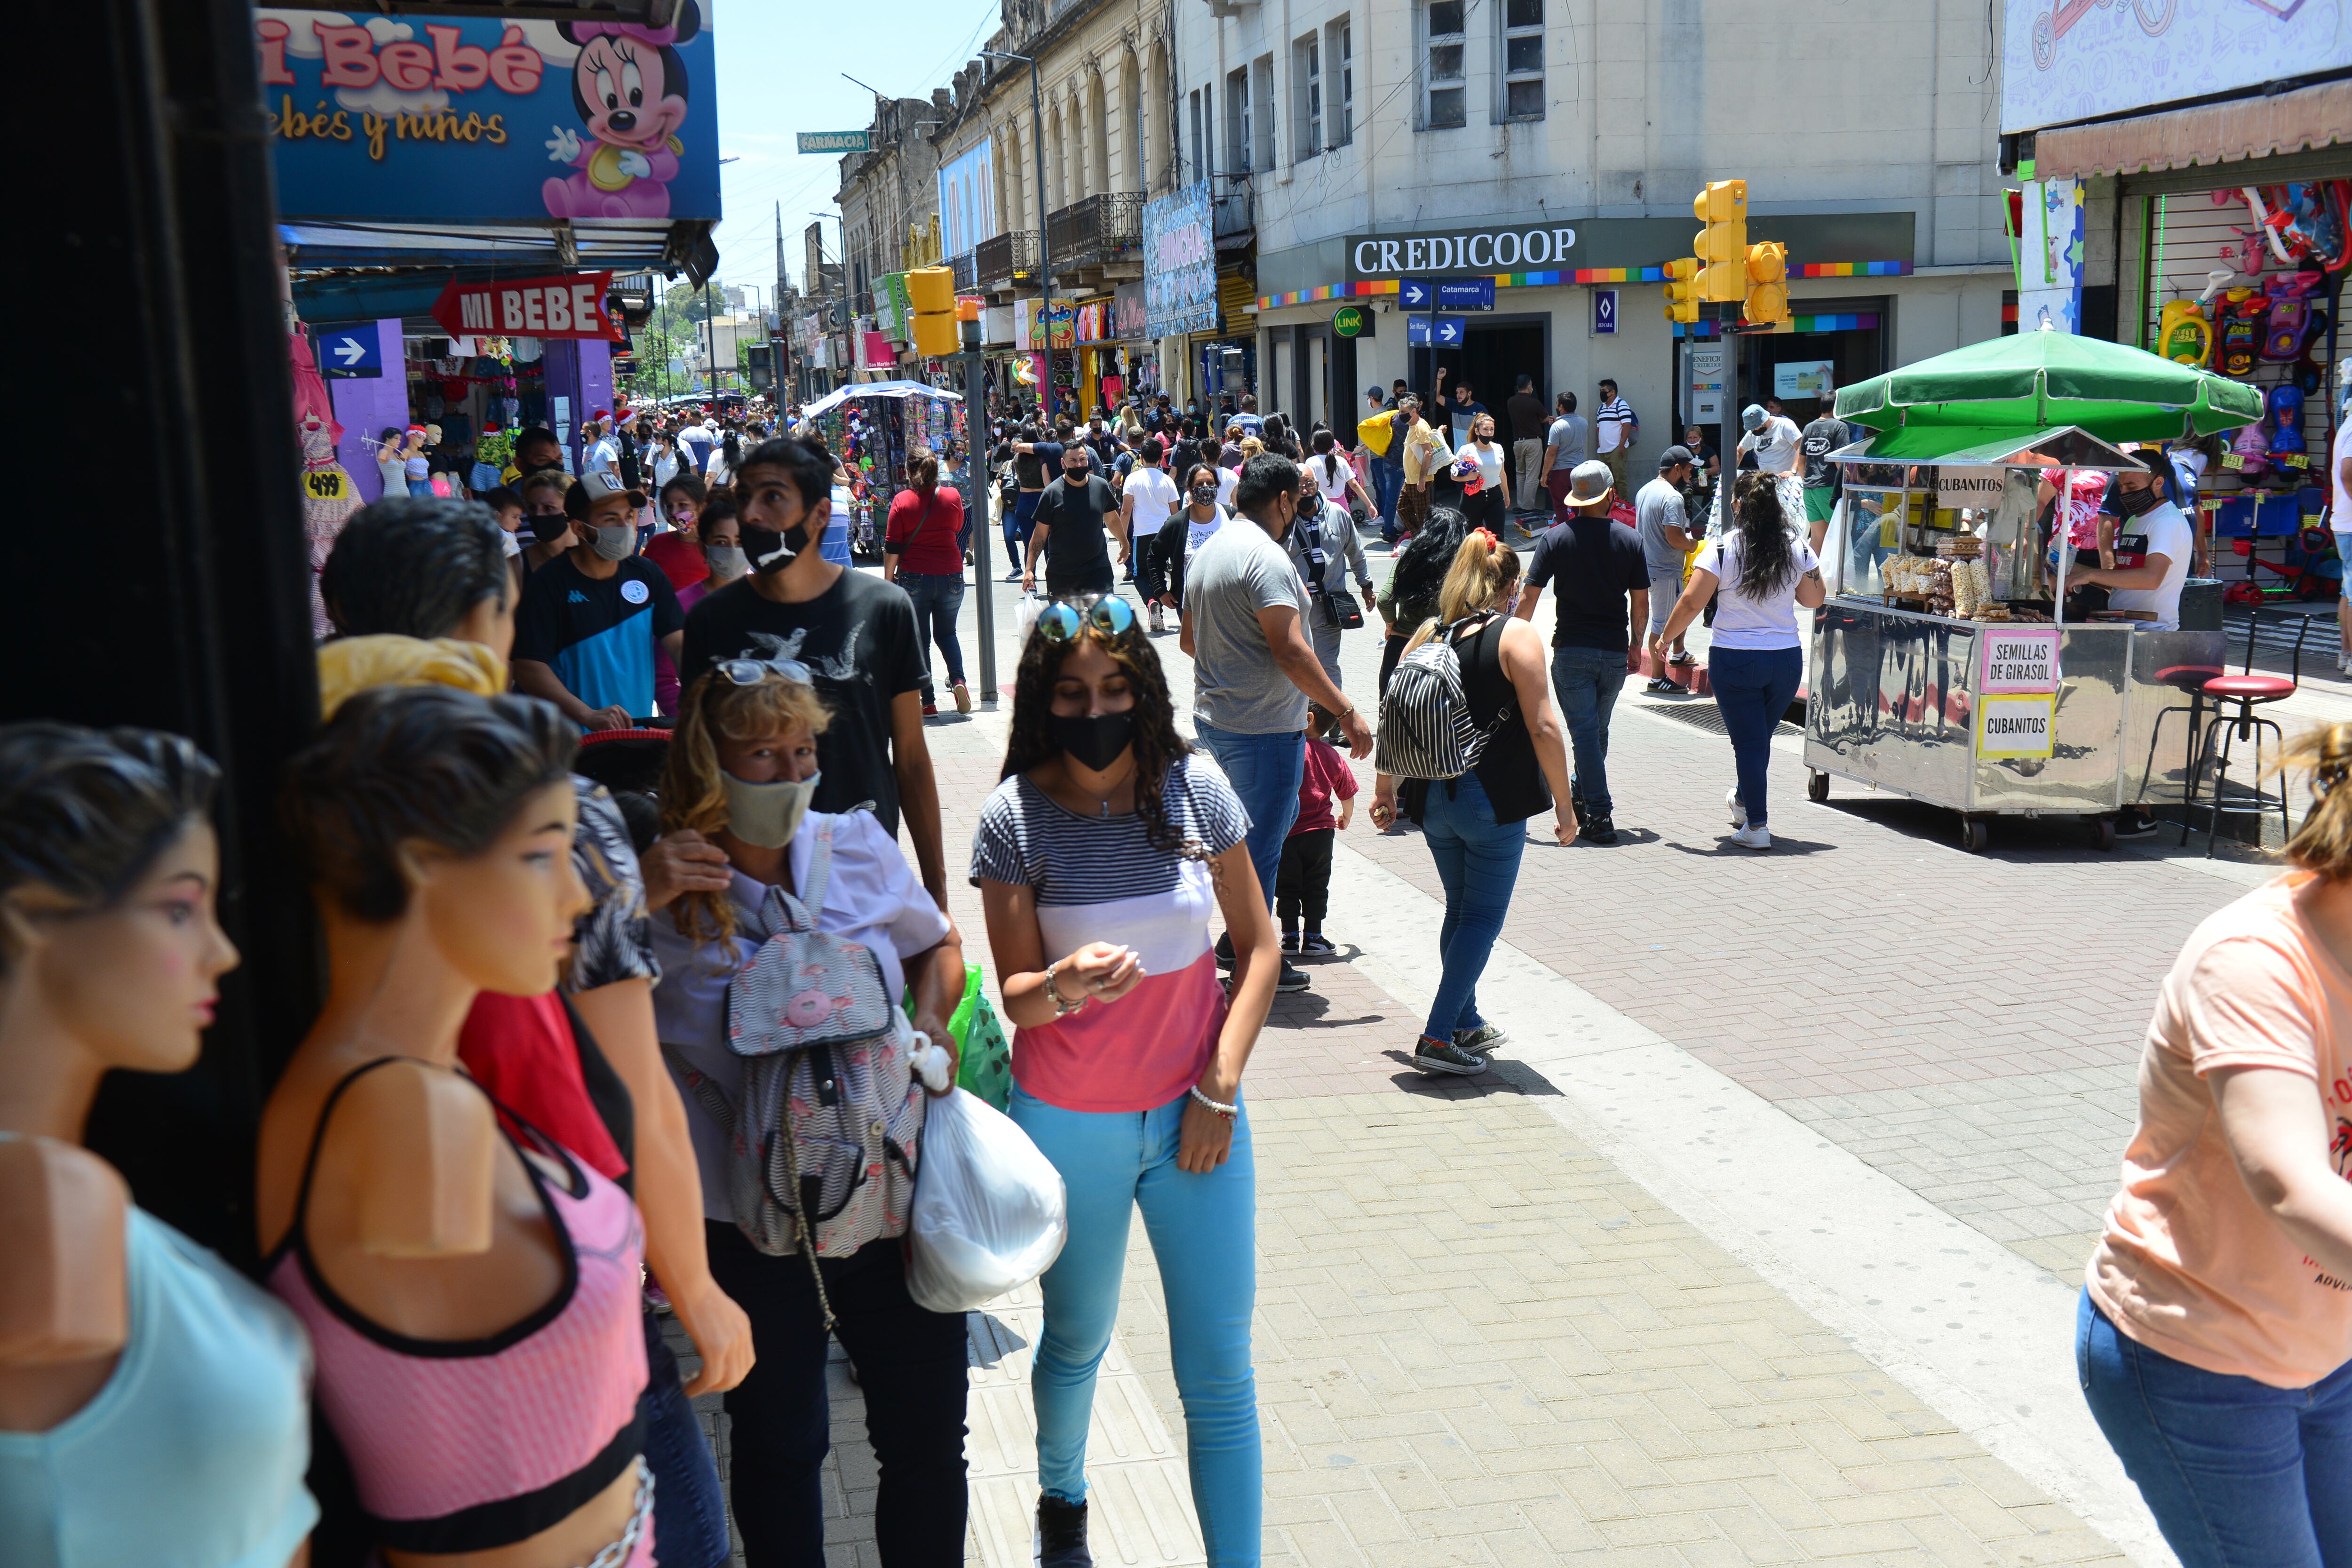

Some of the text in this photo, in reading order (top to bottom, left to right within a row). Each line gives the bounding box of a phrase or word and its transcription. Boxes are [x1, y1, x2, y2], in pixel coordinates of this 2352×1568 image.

[255, 18, 545, 96] i Bebé
[267, 94, 508, 161] ebés y niños
[801, 135, 865, 150] FARMACIA
[1164, 213, 1171, 234] LA
[1159, 222, 1206, 274] HINCHA
[1355, 228, 1576, 273] CREDICOOP
[460, 283, 599, 332] MI BEBE
[1759, 437, 1773, 446] NIKE
[1805, 441, 1826, 452] Ford
[1939, 478, 2002, 492] CUBANITOS
[1996, 644, 2047, 660] SEMILLAS
[1990, 664, 2049, 680] DE GIRASOL
[1987, 717, 2046, 734] CUBANITOS
